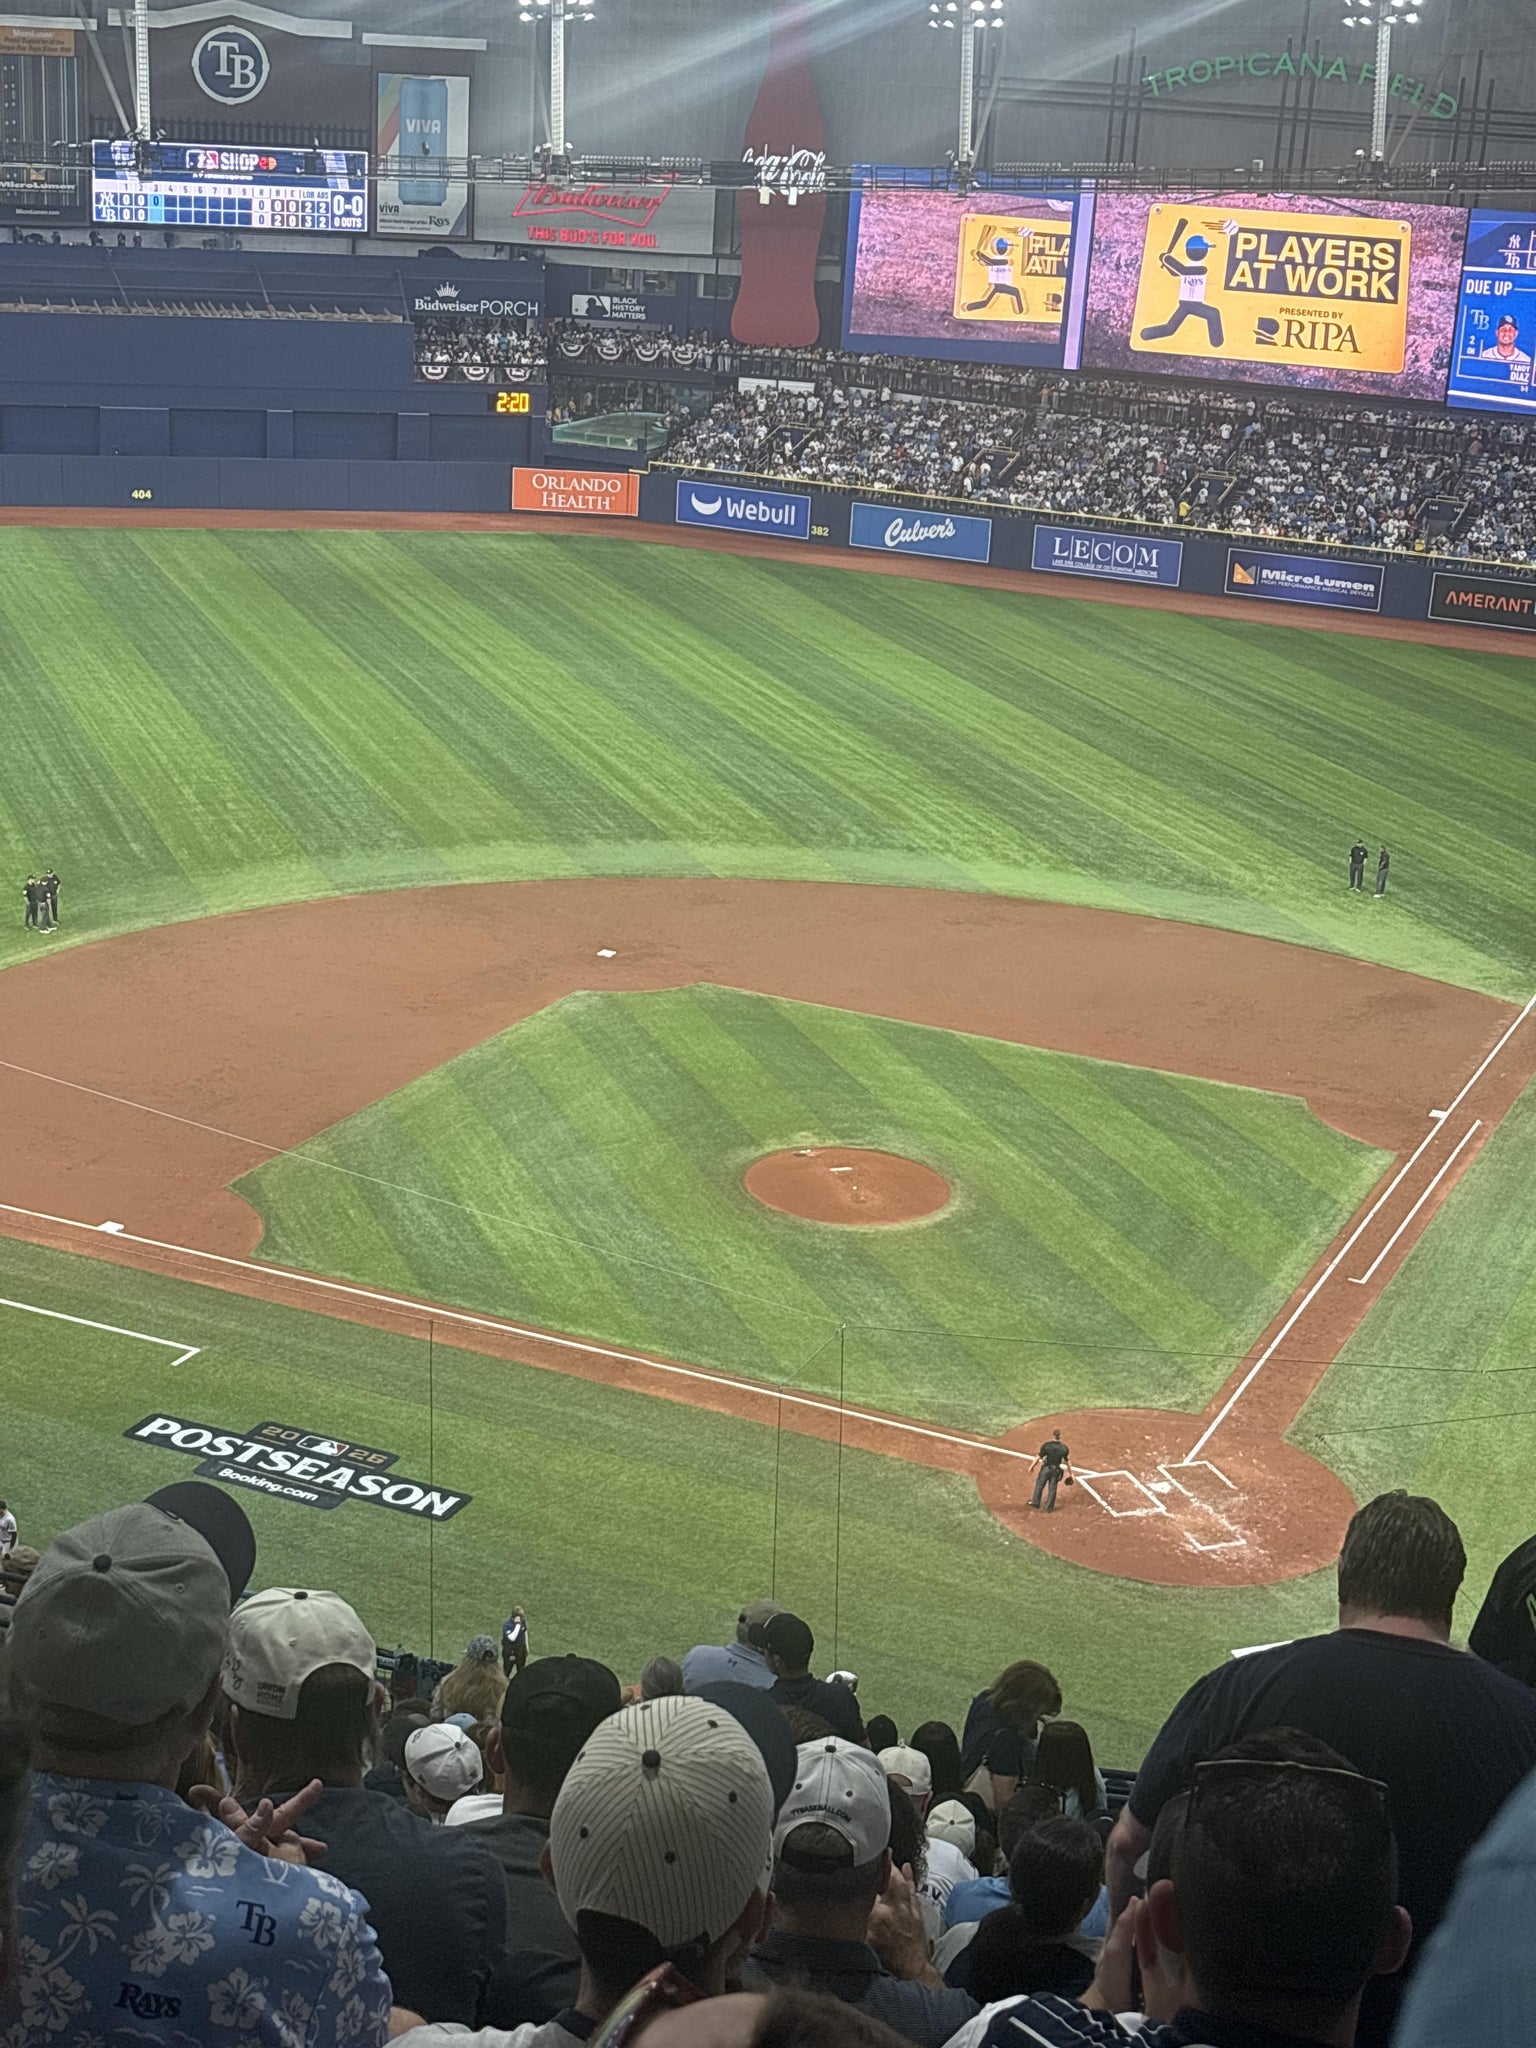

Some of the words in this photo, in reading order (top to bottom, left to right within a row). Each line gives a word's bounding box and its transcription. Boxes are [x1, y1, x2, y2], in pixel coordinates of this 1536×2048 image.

[208, 40, 256, 89] TB
[1142, 51, 1348, 96] TROPICANA
[1358, 62, 1458, 120] FELD
[406, 118, 441, 134] VIVA
[0, 181, 76, 190] MicroLumen
[123, 194, 130, 206] 0
[138, 195, 145, 206] 0
[154, 196, 159, 206] 0
[259, 200, 264, 210] 0
[274, 200, 281, 211] 0
[289, 201, 296, 212] 0
[305, 202, 312, 212] 2
[320, 202, 326, 213] 2
[333, 195, 363, 216] 0-0
[532, 184, 662, 210] Budweiser
[123, 209, 130, 220] 0
[138, 210, 145, 220] 0
[259, 213, 264, 224] 0
[275, 214, 281, 226] 2
[289, 215, 296, 226] 0
[305, 216, 312, 227] 3
[320, 217, 326, 227] 2
[379, 204, 399, 213] VIVA
[342, 217, 362, 228] OUTS
[528, 226, 556, 240] THIS
[601, 231, 626, 246] FOR
[1236, 232, 1396, 271] PLAYERS
[1229, 261, 1275, 289] AT
[1285, 264, 1395, 300] WORK
[1466, 279, 1492, 295] DUE
[1494, 280, 1512, 296] UP
[414, 298, 479, 312] Budweiser
[480, 300, 539, 316] PORCH
[612, 304, 645, 312] HISTORY
[612, 312, 646, 320] MATTERS
[1279, 307, 1330, 318] PRESENTED
[1332, 311, 1343, 319] BY
[1470, 309, 1490, 330] TB
[1282, 318, 1362, 354] RIPA
[1469, 335, 1475, 345] 2
[1510, 372, 1530, 382] DIAZ
[496, 392, 530, 413] 2:20
[532, 473, 622, 493] ORLANDO
[131, 489, 152, 499] 404
[541, 491, 612, 510] HEALTH
[726, 497, 796, 526] Webull
[811, 525, 829, 537] 382
[884, 517, 956, 547] Culver's
[1261, 569, 1374, 591] MicroLumen
[1278, 581, 1320, 591] PERFORMANCE
[1321, 586, 1348, 594] MEDICAL
[1350, 590, 1374, 598] DEVICES
[1445, 590, 1532, 614] AMERANT
[261, 1426, 300, 1440] 20
[134, 1417, 461, 1517] POSTSEASON
[218, 1468, 319, 1501] Booking.com
[236, 1900, 277, 1947] TB
